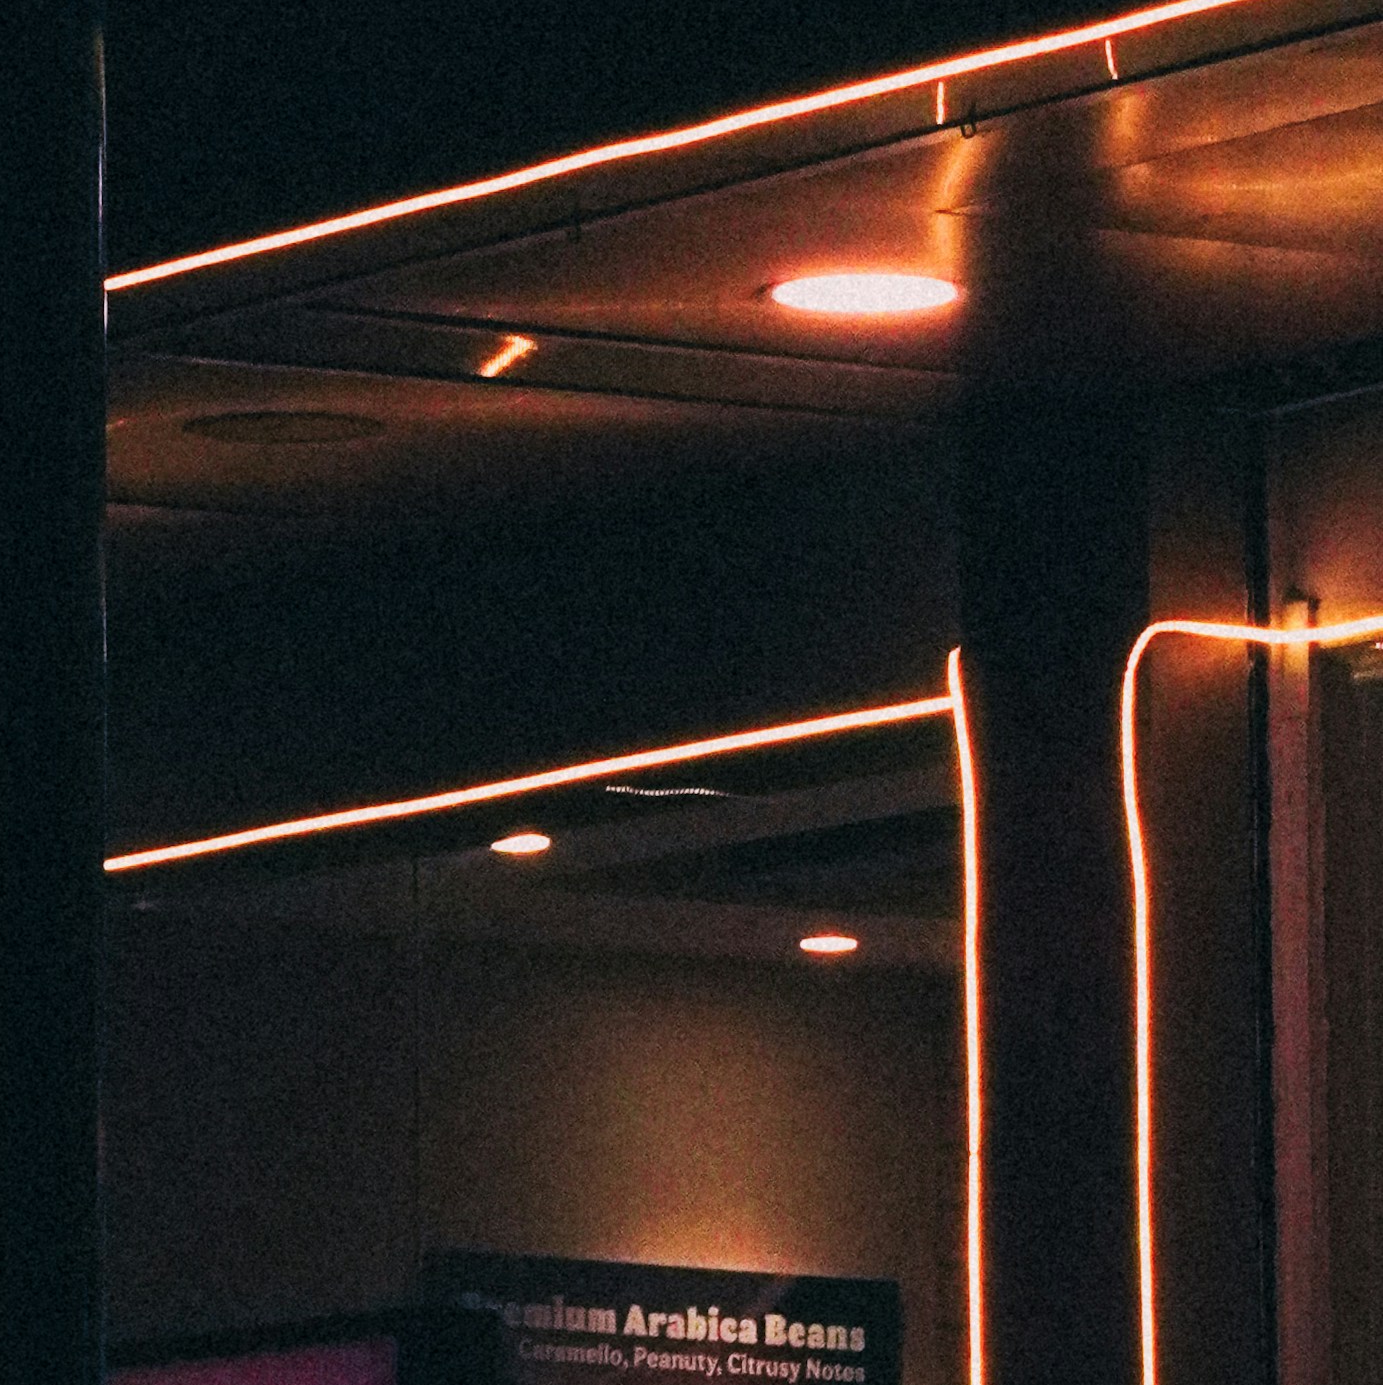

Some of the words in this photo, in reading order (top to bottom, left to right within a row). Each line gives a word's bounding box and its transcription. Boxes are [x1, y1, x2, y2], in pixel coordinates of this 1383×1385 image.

[623, 1303, 758, 1346] Arabica
[764, 1314, 866, 1353] Beans
[633, 1345, 722, 1377] Peanuty,
[727, 1354, 801, 1384] Citrusy
[805, 1358, 866, 1383] Notes
